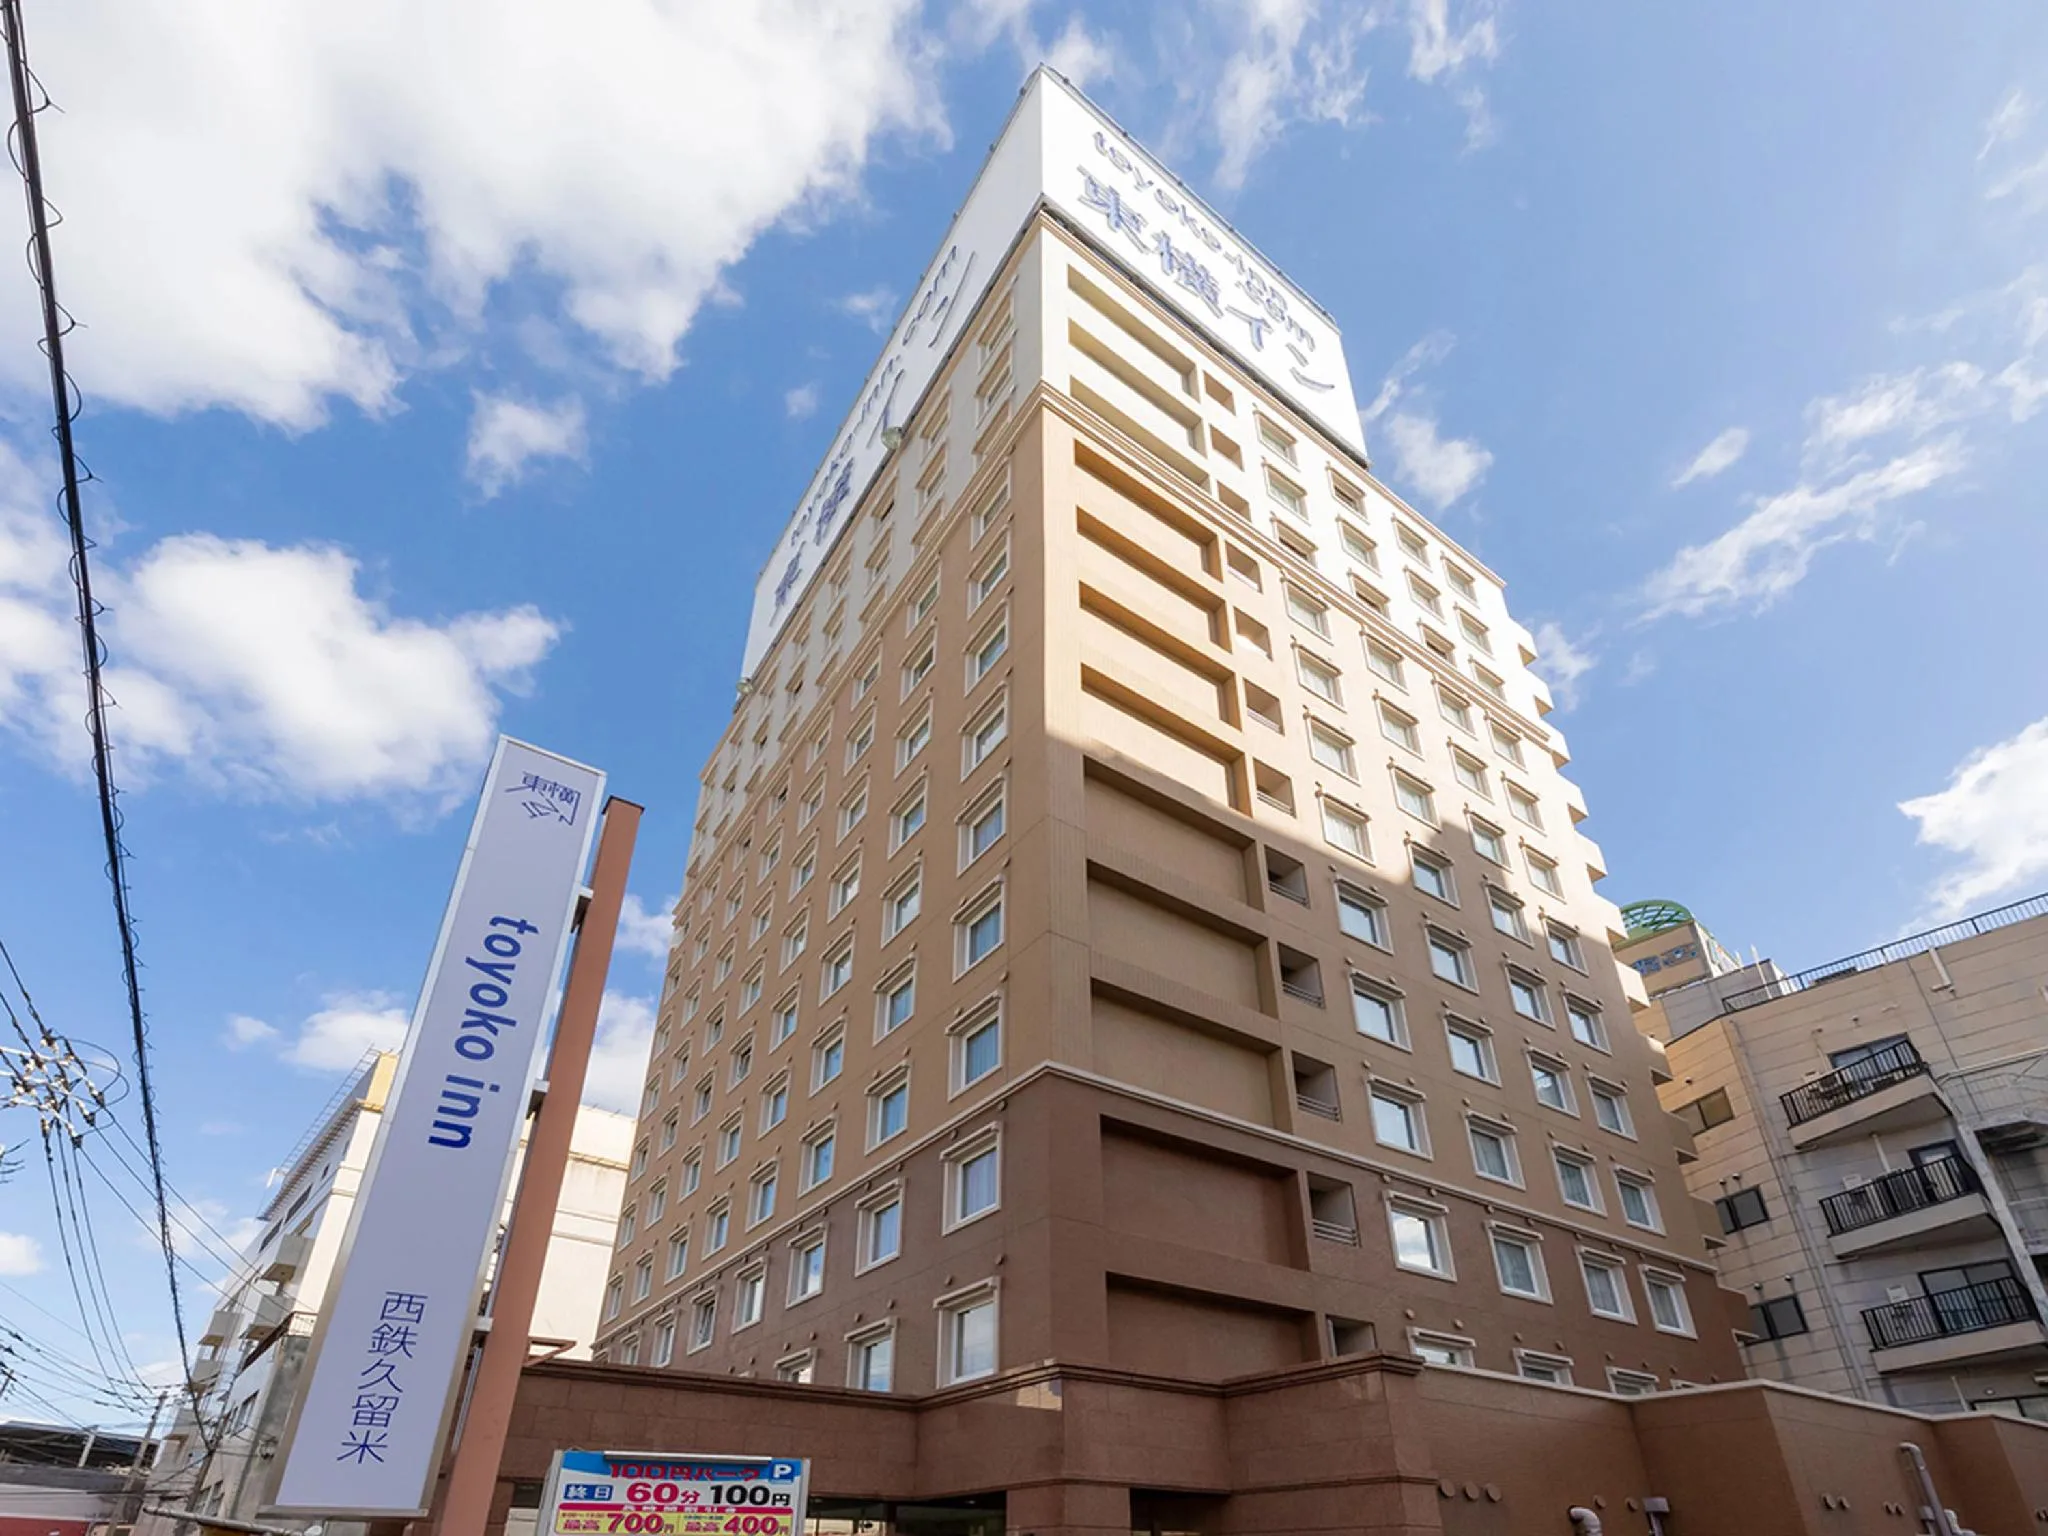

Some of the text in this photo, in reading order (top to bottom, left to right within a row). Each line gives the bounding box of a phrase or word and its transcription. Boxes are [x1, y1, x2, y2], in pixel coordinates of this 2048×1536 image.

[1077, 165, 1335, 392] 東横イン
[428, 915, 540, 1149] toyoko inn
[337, 1290, 429, 1464] 西鉄久留米
[566, 1482, 791, 1507] 終日 60分 100円
[773, 1463, 792, 1479] P
